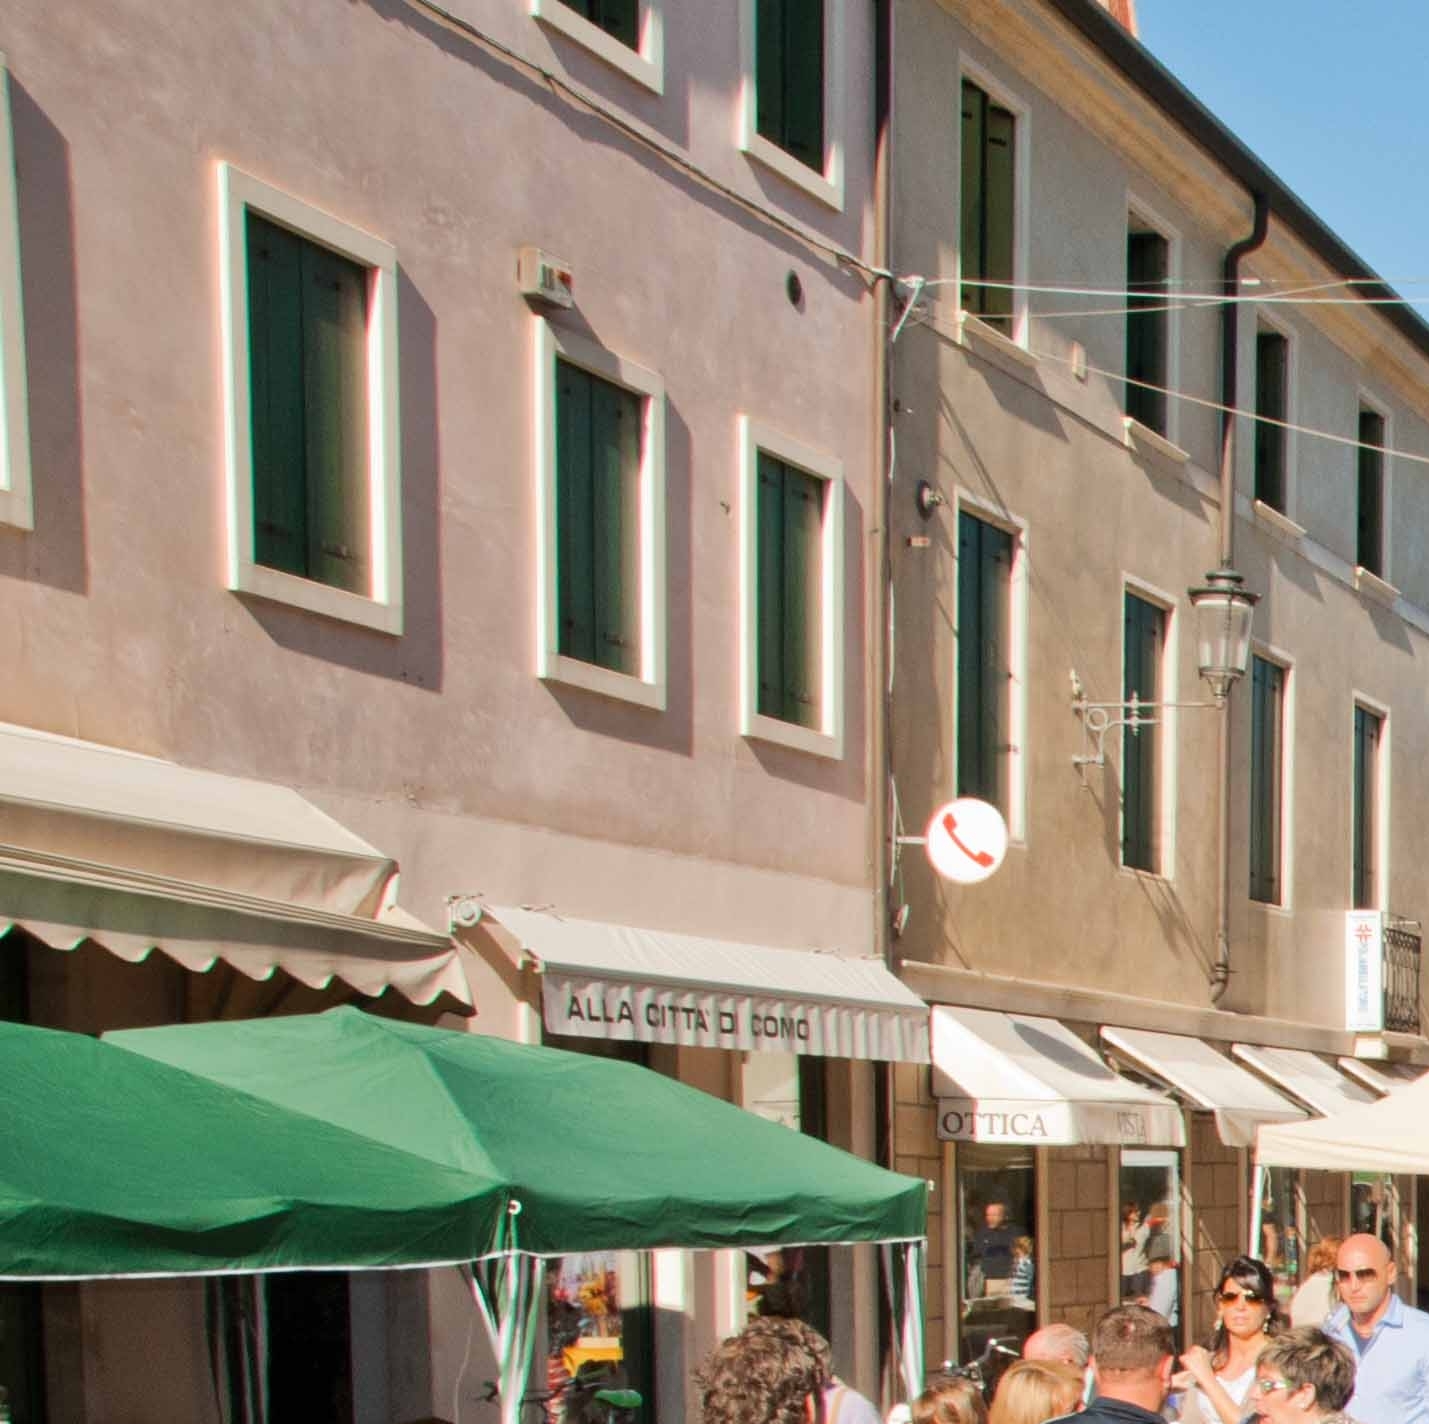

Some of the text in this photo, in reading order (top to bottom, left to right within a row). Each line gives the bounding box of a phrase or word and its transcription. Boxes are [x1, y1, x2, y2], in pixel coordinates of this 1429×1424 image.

[567, 994, 635, 1025] ALLA
[718, 1011, 739, 1035] DI
[751, 1013, 811, 1041] COMO
[941, 1111, 1049, 1137] OTTICA
